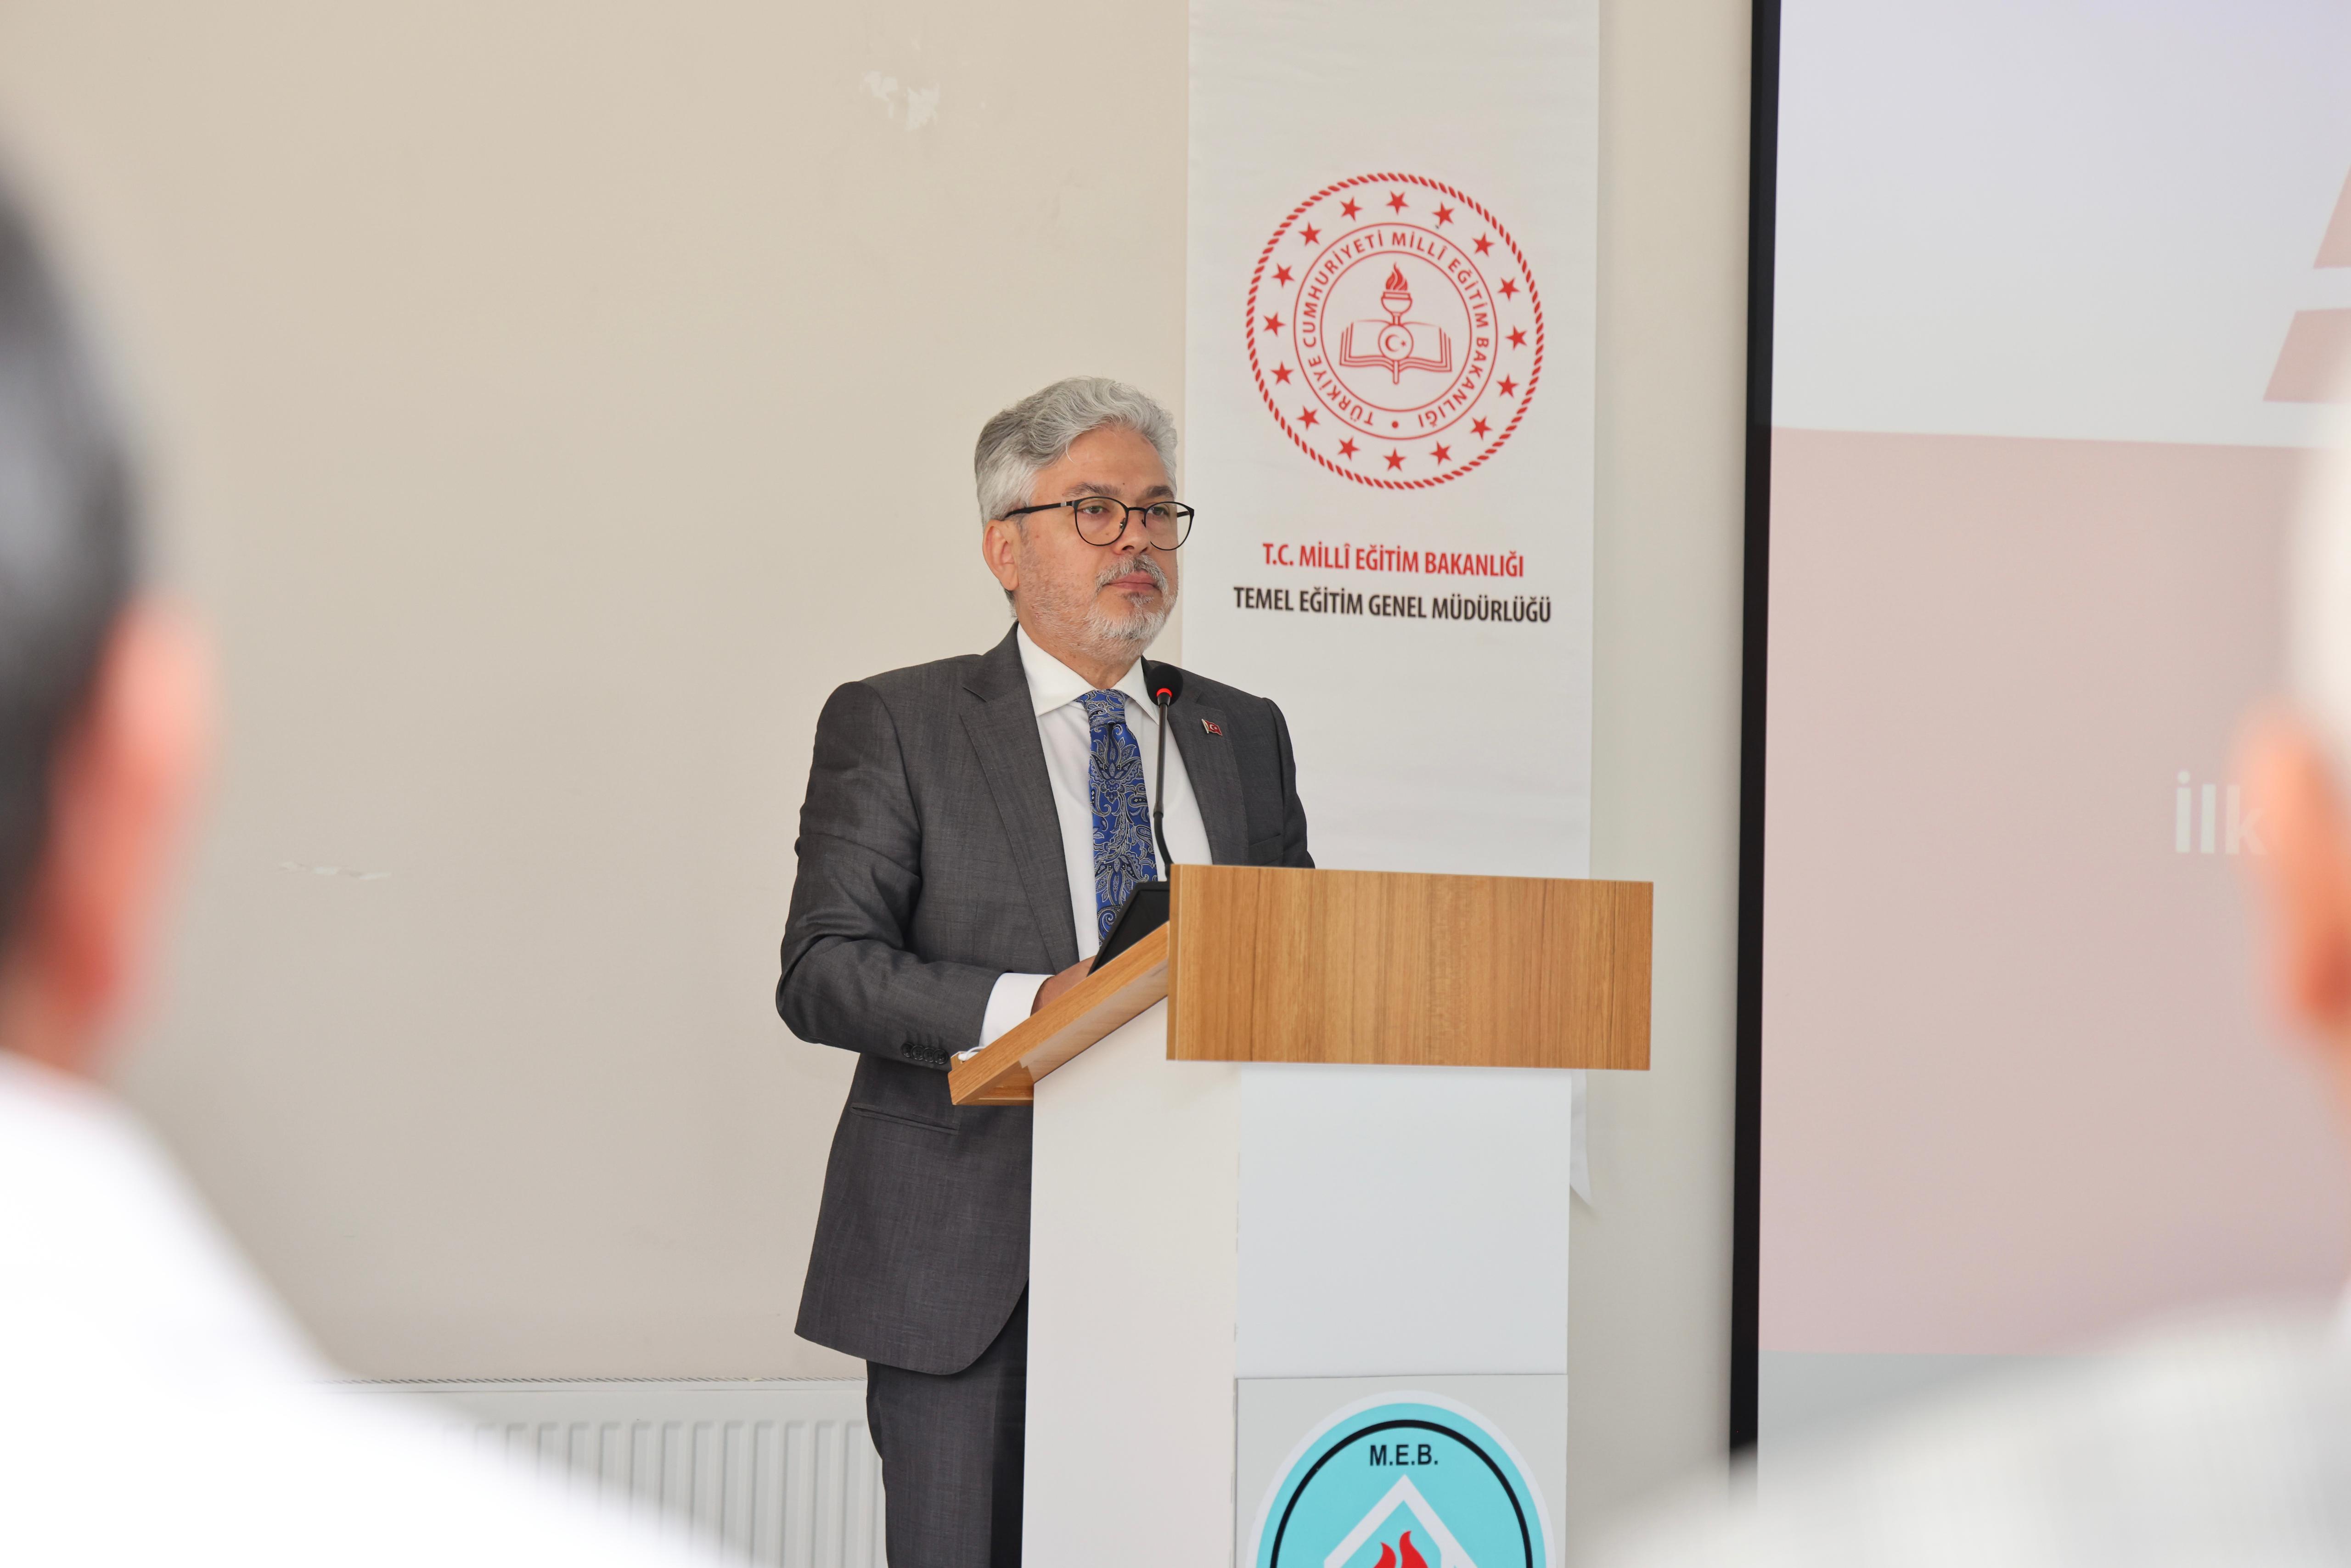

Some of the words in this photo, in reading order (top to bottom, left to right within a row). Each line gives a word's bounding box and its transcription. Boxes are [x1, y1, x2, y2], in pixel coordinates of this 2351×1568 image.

[1302, 229, 1384, 348] CUMHURİYETİ
[1447, 257, 1490, 328] EĞİTİM
[1308, 355, 1374, 427] TÜRKİYE
[1418, 337, 1490, 428] BAKANLIĞI
[1263, 543, 1294, 566] T.C.
[1299, 540, 1351, 570] MİLLÎ
[1355, 544, 1419, 573] EĞİTİM
[1424, 551, 1524, 578] BAKANLIĞI
[1233, 587, 1294, 611] TEMEL
[1300, 587, 1363, 615] EĞİTİM
[1369, 595, 1427, 618] GENEL
[1432, 594, 1551, 623] MÜDÜRLÜĞÜ
[2175, 770, 2267, 856] İlk
[1369, 1444, 1438, 1466] M.E.B.
